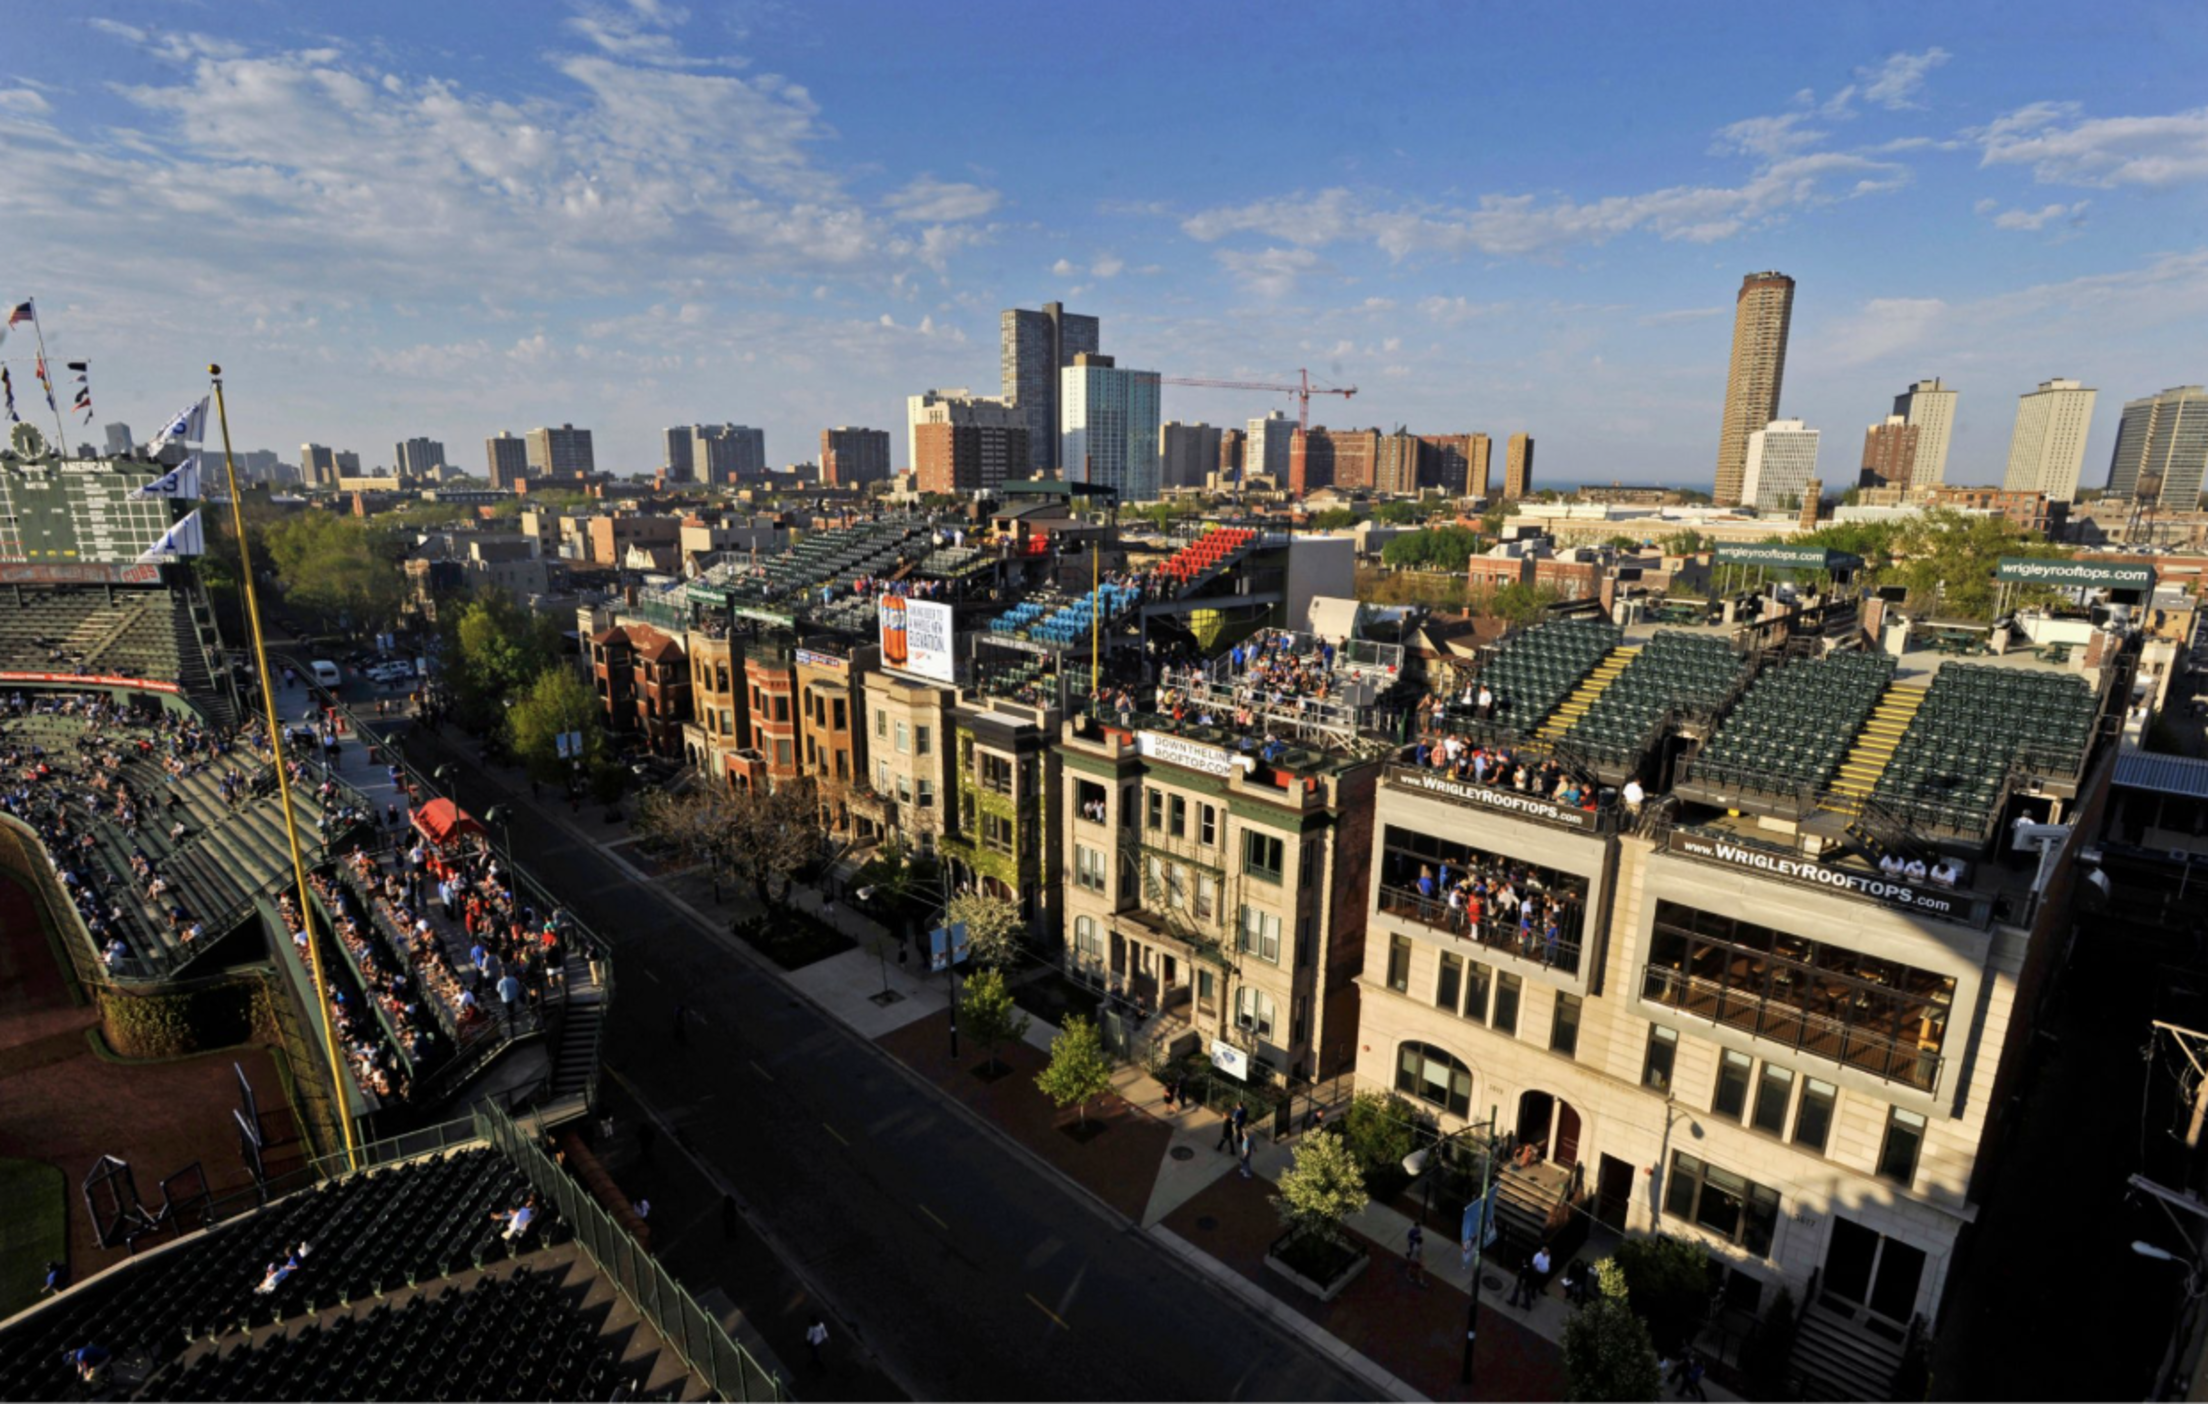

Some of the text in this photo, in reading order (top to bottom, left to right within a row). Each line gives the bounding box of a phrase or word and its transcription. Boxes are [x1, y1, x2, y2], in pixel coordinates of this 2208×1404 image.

[60, 462, 113, 472] AMERICAN
[1718, 547, 1824, 562] wrigleyrooftops.com
[121, 565, 158, 582] CUBS
[2002, 563, 2148, 581] wrigleyrooftops.com
[1400, 776, 1583, 824] www.WRIGLEYROOFTOPS.com
[1684, 841, 1951, 912] www.WRIGLEYROOFTOPS.com
